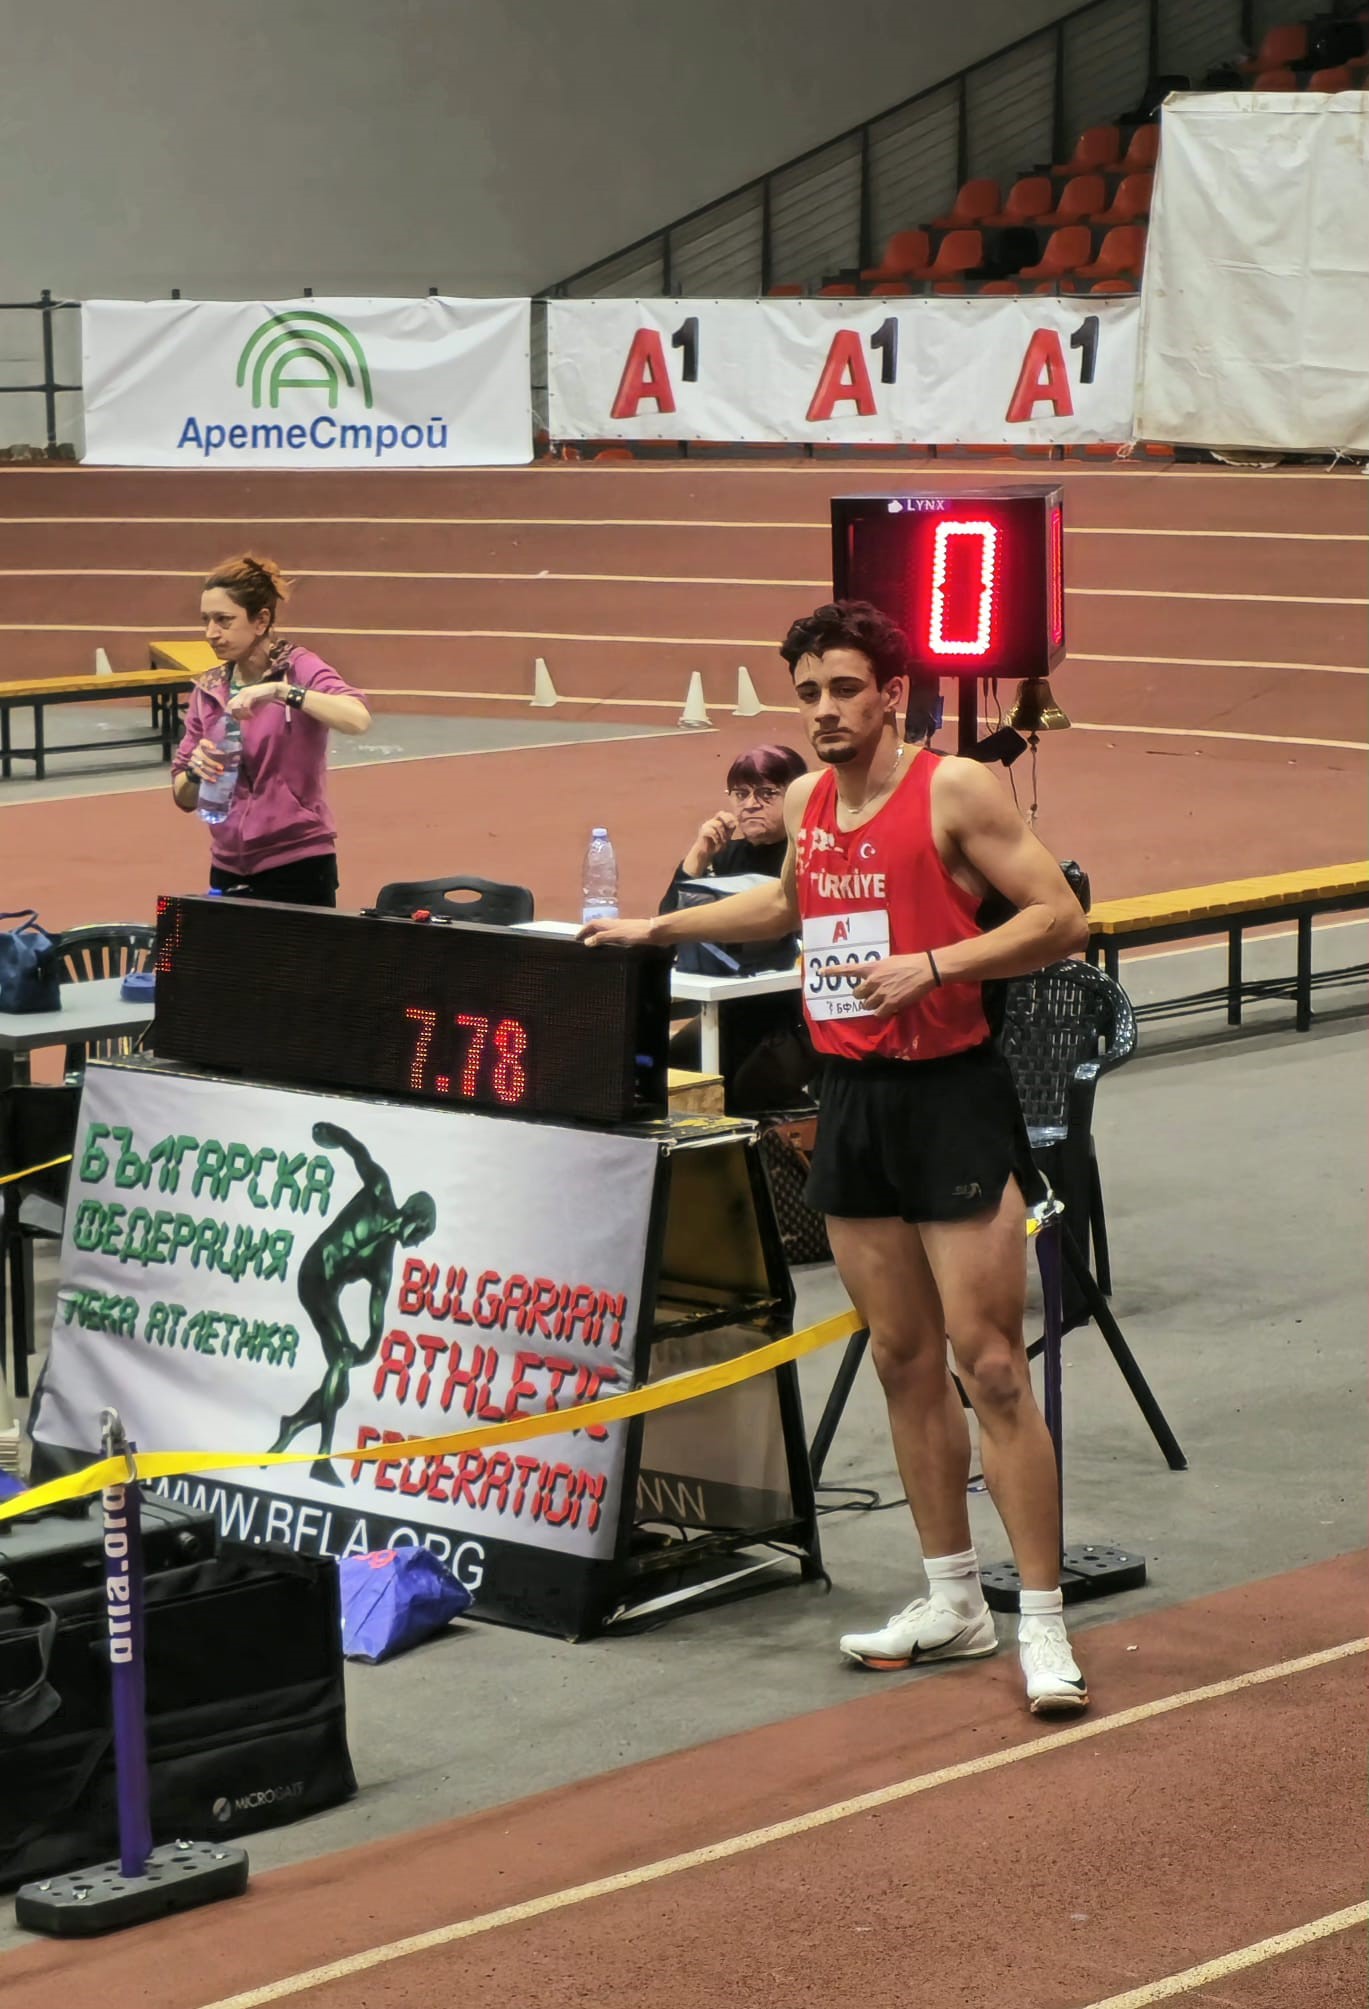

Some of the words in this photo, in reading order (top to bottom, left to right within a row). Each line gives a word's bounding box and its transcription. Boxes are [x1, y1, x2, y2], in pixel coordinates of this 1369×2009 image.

[609, 316, 699, 419] A1
[805, 317, 899, 422] A1
[1005, 315, 1099, 423] A1
[907, 499, 945, 511] LYNX
[929, 521, 997, 654] 0
[405, 1008, 527, 1102] 7.78
[80, 1122, 335, 1217] БЪЛГАРСКА
[73, 1200, 295, 1283] ФЕДЕРАЦИЯ
[144, 1301, 300, 1368] АТЛЕТИКА
[398, 1258, 627, 1348] BULGARIAN
[350, 1425, 608, 1534] FEDERATION
